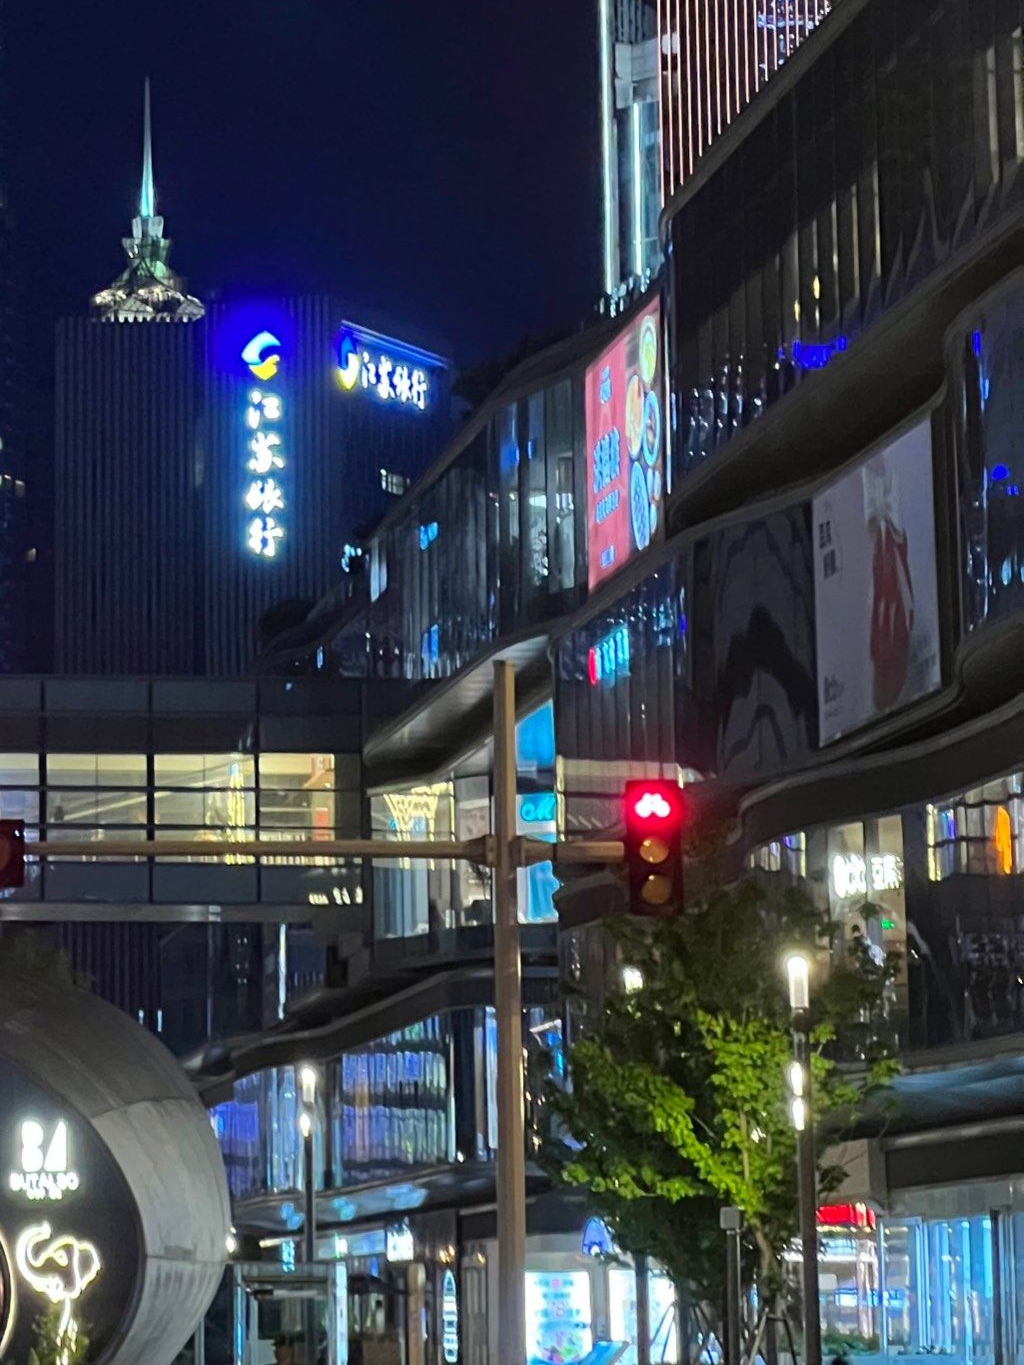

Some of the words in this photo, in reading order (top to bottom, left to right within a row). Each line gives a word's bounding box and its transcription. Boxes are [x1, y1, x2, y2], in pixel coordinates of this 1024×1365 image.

[362, 351, 427, 411] 江苏银行
[245, 390, 285, 558] 江苏银行
